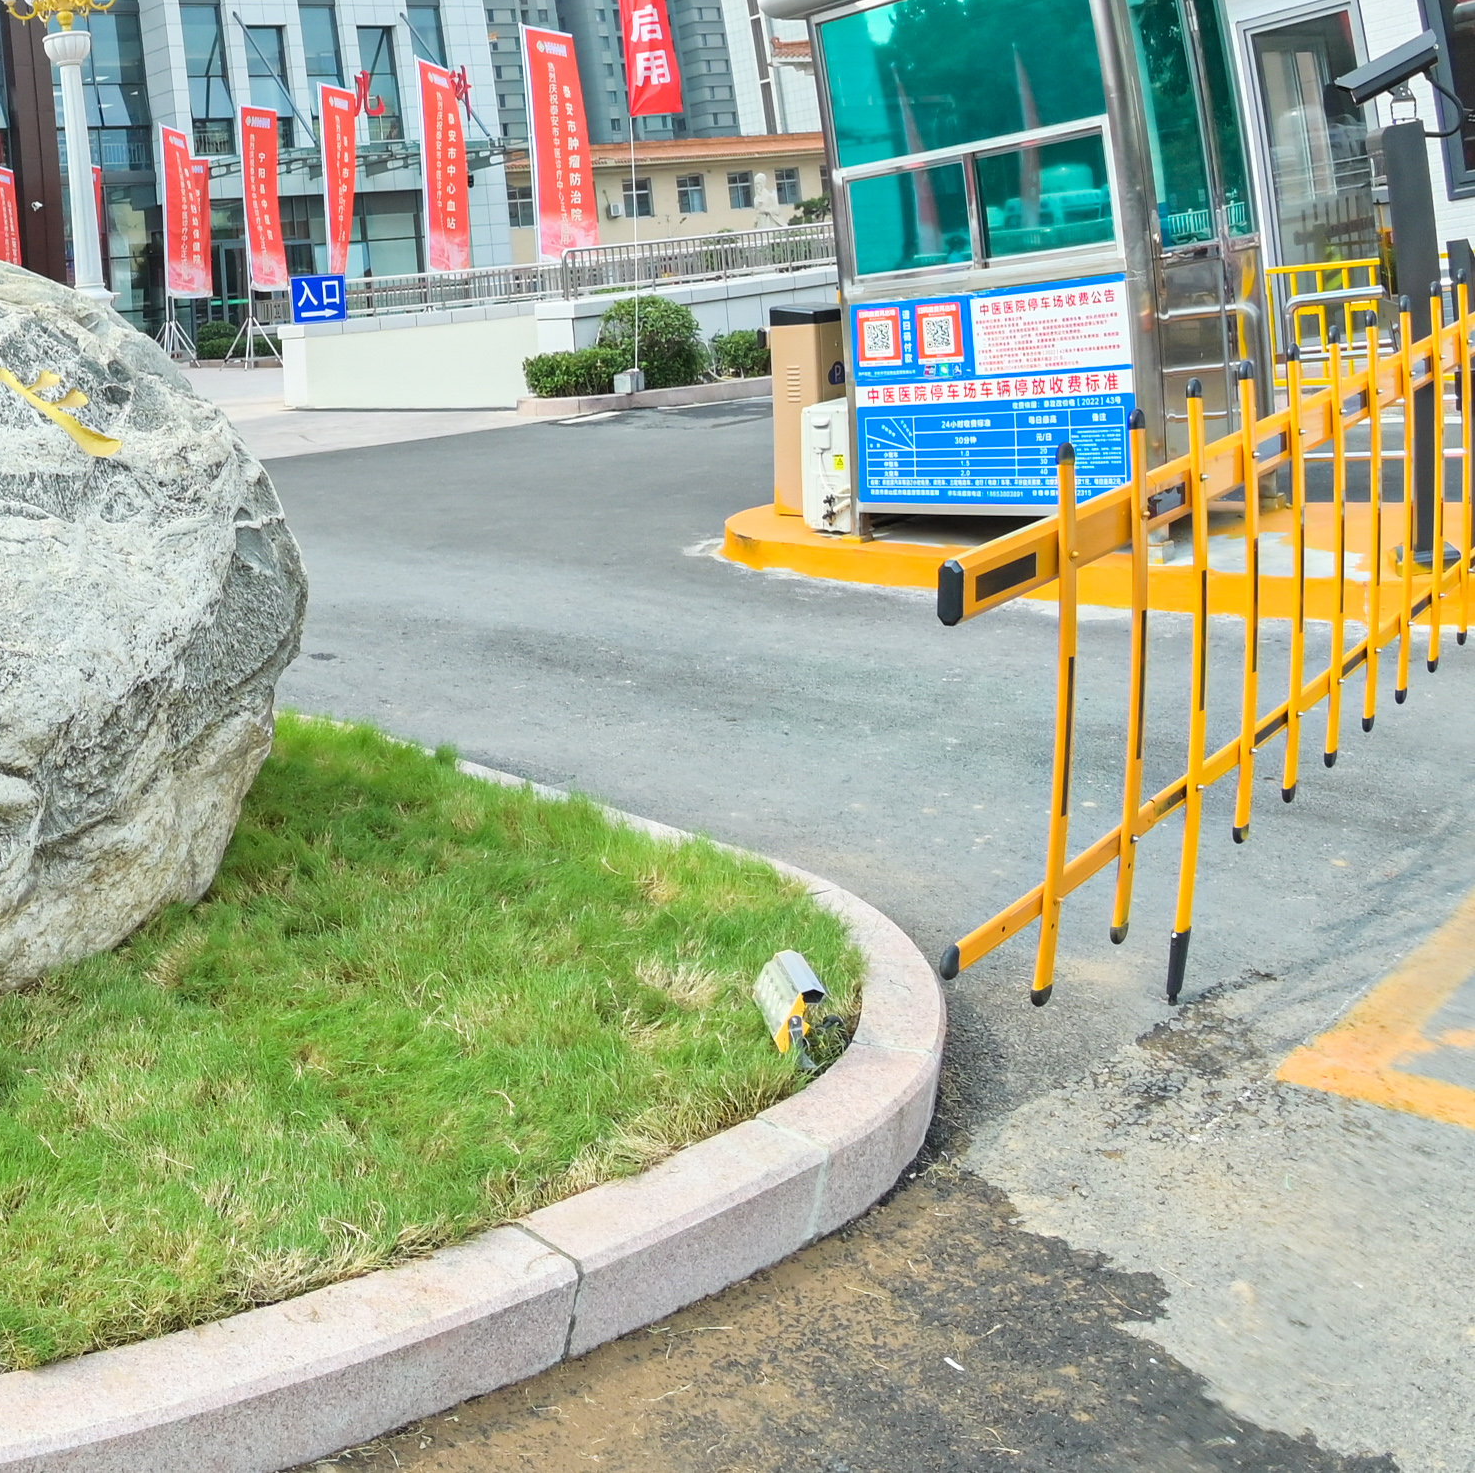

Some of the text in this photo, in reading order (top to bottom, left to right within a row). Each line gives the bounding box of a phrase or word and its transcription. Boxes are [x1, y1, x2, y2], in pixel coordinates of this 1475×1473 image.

[446, 113, 458, 230] 泰安市中心血站
[562, 85, 584, 223] 泰安市肿瘤防治院
[258, 152, 274, 241] 宁阳县中医院
[298, 280, 341, 307] 入口
[979, 288, 1116, 316] 中医医院停车场收费公告
[867, 374, 1120, 404] 中医医院停车场车辆停放收费标准
